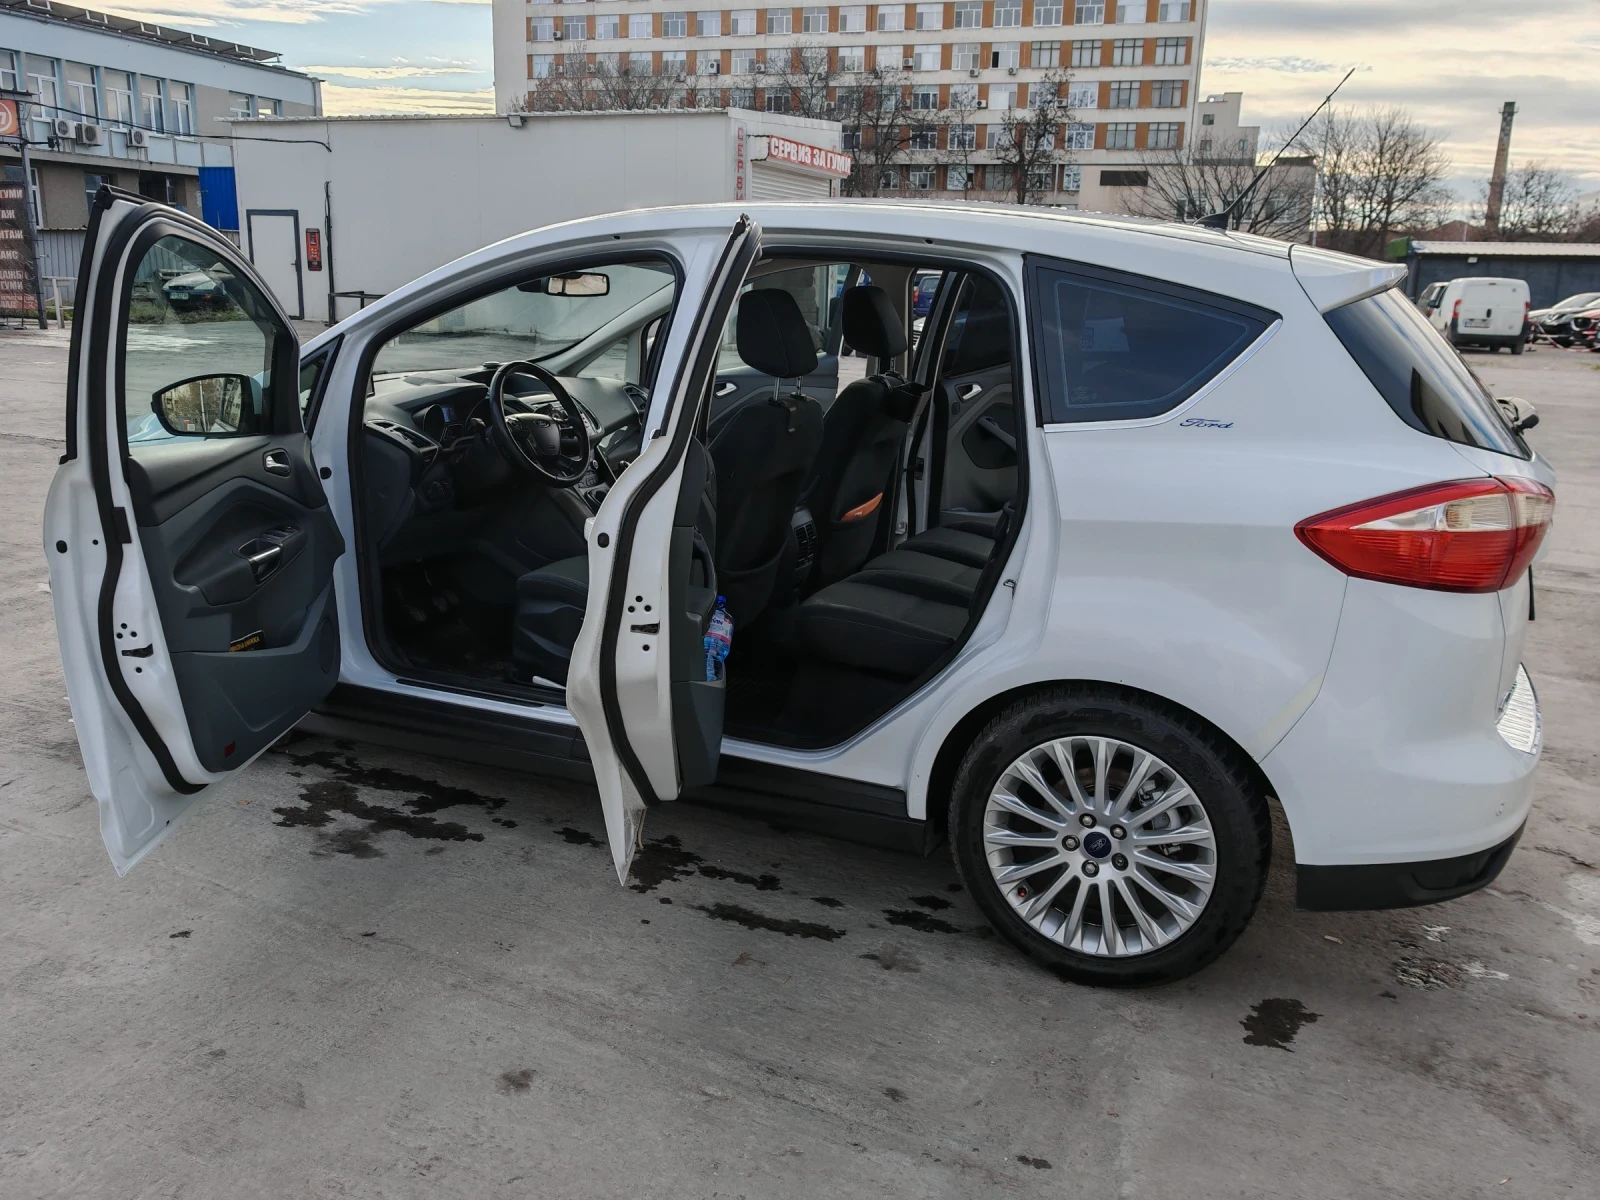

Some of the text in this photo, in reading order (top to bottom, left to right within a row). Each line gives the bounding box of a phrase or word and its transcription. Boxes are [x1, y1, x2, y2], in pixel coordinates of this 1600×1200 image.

[770, 138, 812, 164] СЕРВИЗ
[813, 148, 827, 167] ЗА
[827, 152, 851, 173] ГУМИ
[1180, 418, 1234, 428] Ford
